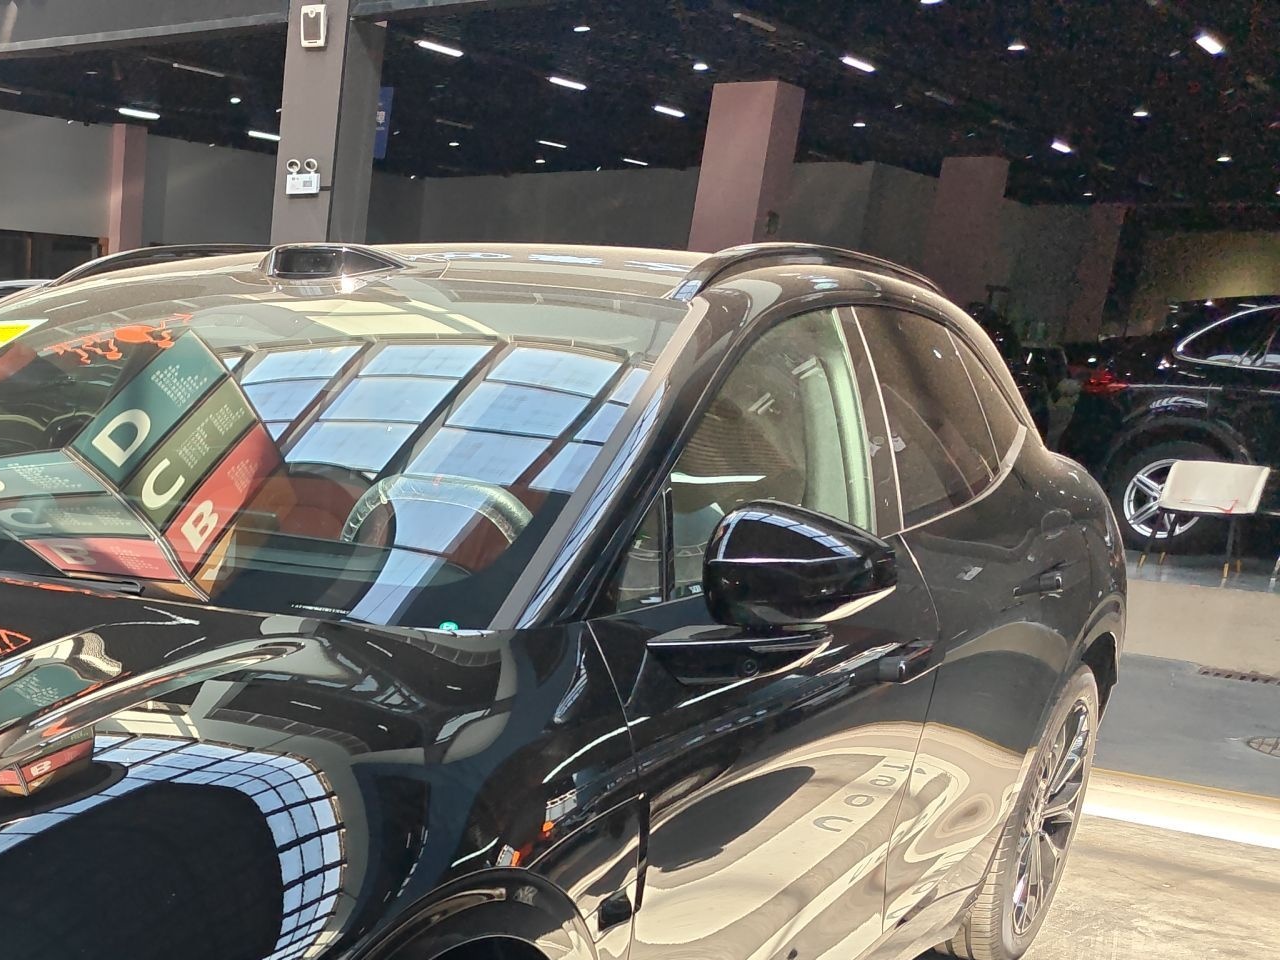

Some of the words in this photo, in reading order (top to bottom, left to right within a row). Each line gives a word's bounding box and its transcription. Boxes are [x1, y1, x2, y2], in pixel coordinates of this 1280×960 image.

[91, 409, 151, 467] D
[141, 458, 186, 511] C
[180, 500, 219, 553] B
[47, 542, 96, 565] B
